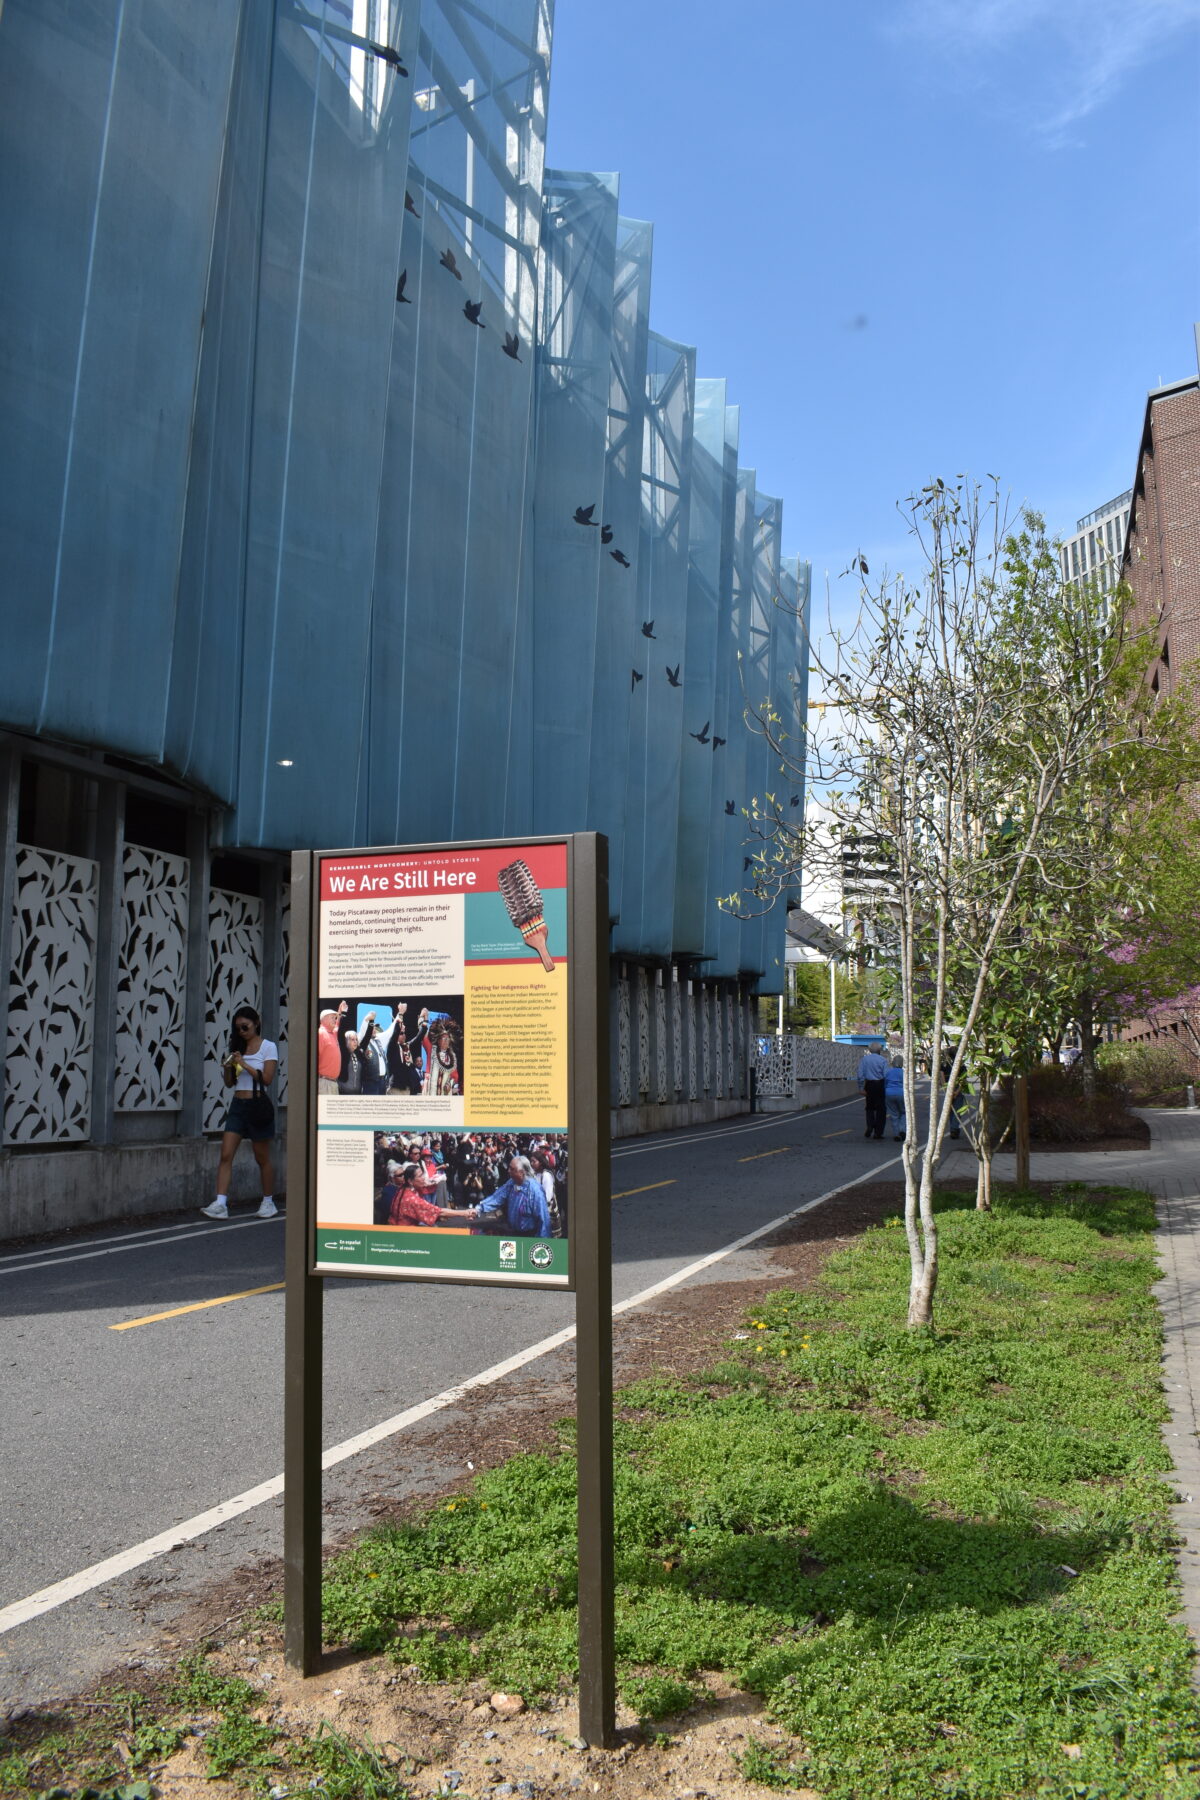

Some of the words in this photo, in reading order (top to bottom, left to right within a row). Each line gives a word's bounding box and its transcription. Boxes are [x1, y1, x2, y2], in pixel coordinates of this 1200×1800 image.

[330, 876, 355, 892] We
[360, 874, 389, 891] Are
[394, 872, 429, 889] Still
[433, 869, 476, 887] Here
[348, 908, 380, 917] Piscataway
[329, 919, 364, 927] homelands,
[329, 928, 358, 936] exercising
[374, 926, 403, 935] sovereign
[404, 926, 423, 934] rights.
